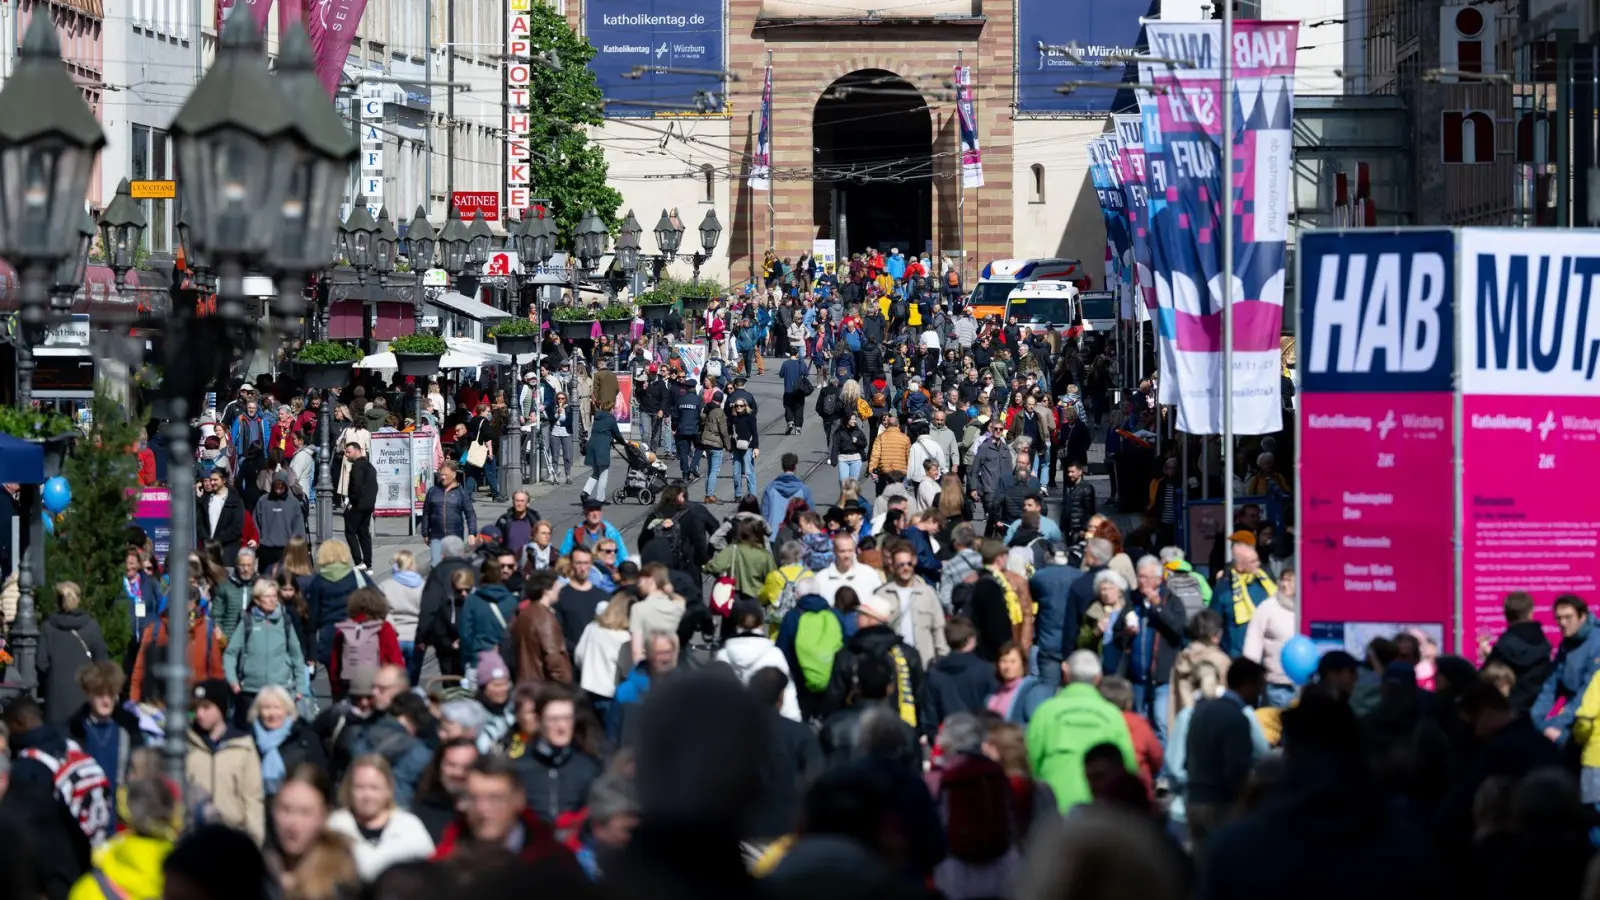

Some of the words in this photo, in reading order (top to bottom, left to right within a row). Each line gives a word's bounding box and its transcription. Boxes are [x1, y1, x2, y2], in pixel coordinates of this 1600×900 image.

[603, 14, 705, 27] katholikentag.de
[603, 44, 650, 54] Katholikentag
[673, 44, 705, 54] Würzburg
[510, 16, 528, 206] APOTHEKE
[454, 195, 496, 206] SATINEE
[1308, 252, 1445, 373] HAB
[1308, 414, 1372, 431] Katholikentag
[1472, 414, 1532, 432] Katholikentag
[380, 448, 405, 456] Neuwahl
